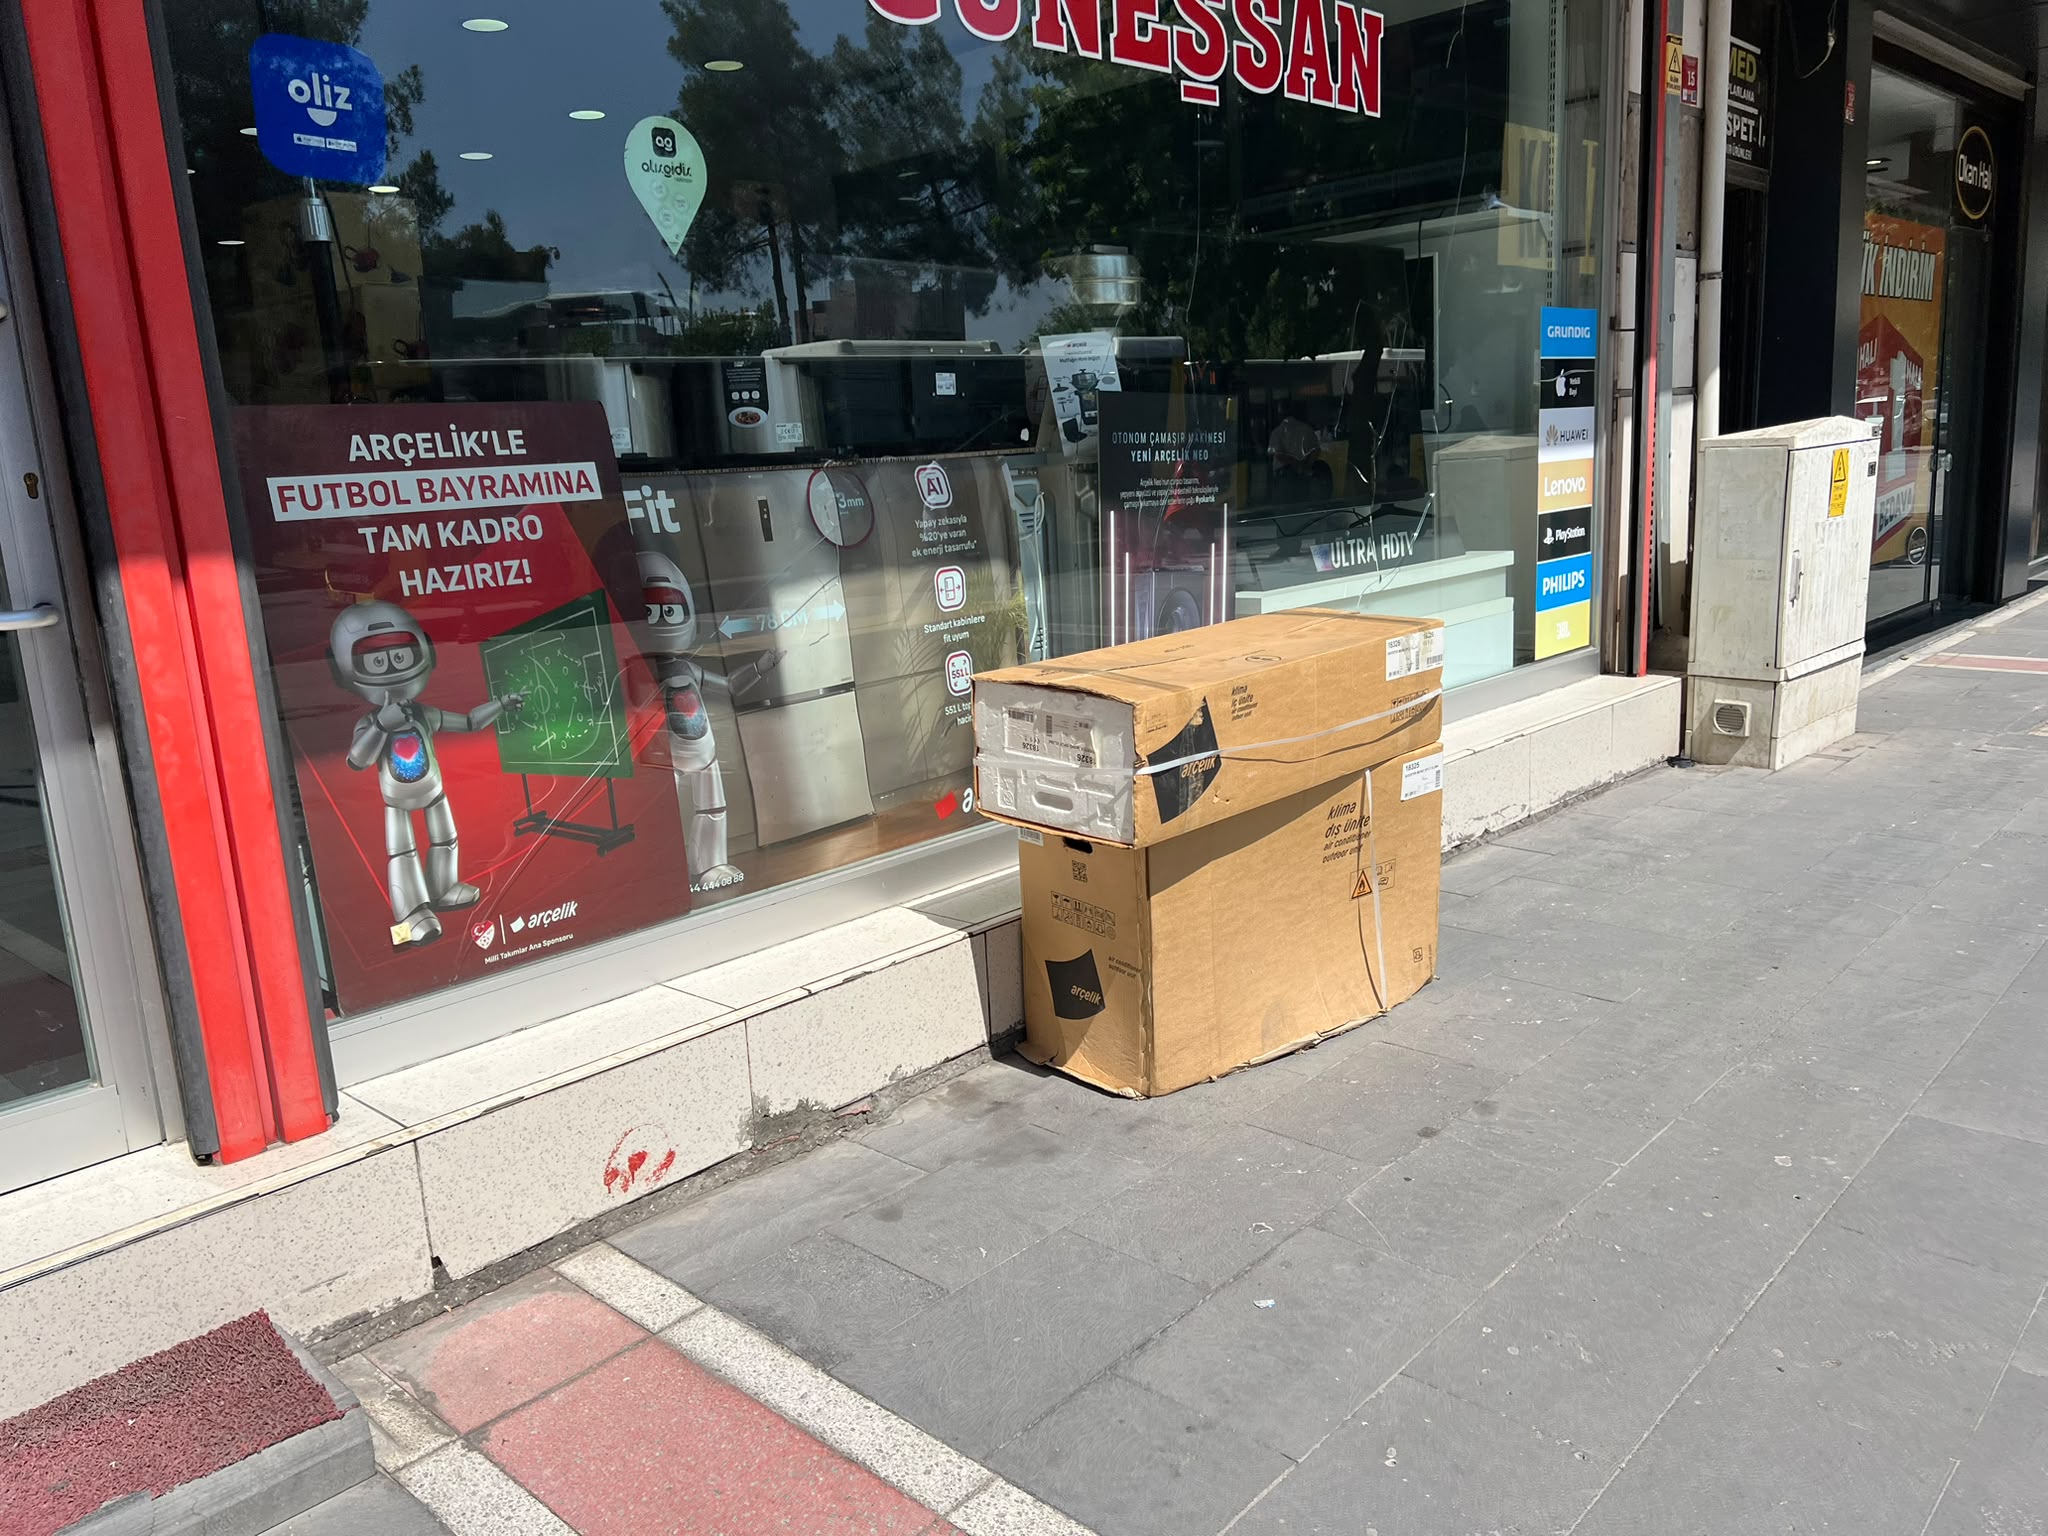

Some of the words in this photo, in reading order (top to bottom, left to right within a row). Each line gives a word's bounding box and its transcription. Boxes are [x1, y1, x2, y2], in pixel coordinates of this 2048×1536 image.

[868, 0, 1384, 117] NEŞSAN
[288, 72, 352, 110] oliz
[1879, 234, 1936, 300] İNDİRİM
[1547, 326, 1591, 339] GRUNDIG
[349, 424, 527, 466] ARÇELİK'LE
[1112, 432, 1146, 444] OTONOM
[1150, 432, 1185, 446] ÇAMAŞIR
[1560, 428, 1588, 442] HUAWEI
[1131, 448, 1151, 462] YENİ
[1154, 448, 1190, 464] ARÇELİK
[277, 480, 411, 512] FUTBOL
[416, 470, 595, 505] BAYRAMINA
[927, 477, 944, 496] AI
[1544, 476, 1586, 497] Lenovo
[623, 485, 680, 536] Fit
[915, 519, 936, 528] Yapay
[939, 515, 967, 526] zekasıyla
[358, 524, 432, 554] TAM
[438, 515, 543, 548] KADRO
[949, 530, 966, 538] varan
[1556, 527, 1586, 543] PlayStation
[912, 548, 921, 557] ek
[923, 544, 944, 555] enerji
[1331, 536, 1376, 568] ULTRA
[400, 558, 532, 597] HAZIRIZ!
[1542, 570, 1585, 596] PHILIPS
[924, 621, 953, 633] Standart
[952, 669, 964, 679] 551
[1327, 802, 1357, 820] klima
[1325, 823, 1341, 839] dış
[1344, 815, 1371, 833] ünite
[1324, 840, 1334, 851] air
[1335, 831, 1371, 848] conditioner
[1322, 849, 1348, 864] outdoor
[702, 881, 720, 891] 444
[721, 877, 732, 886] 08
[734, 873, 744, 883] 88
[528, 901, 578, 928] arçelik
[485, 952, 499, 964] Milli
[500, 947, 528, 960] Takımlar
[529, 943, 541, 951] Ana
[542, 933, 574, 947] Sponsoru
[1070, 985, 1101, 1005] arçelik
